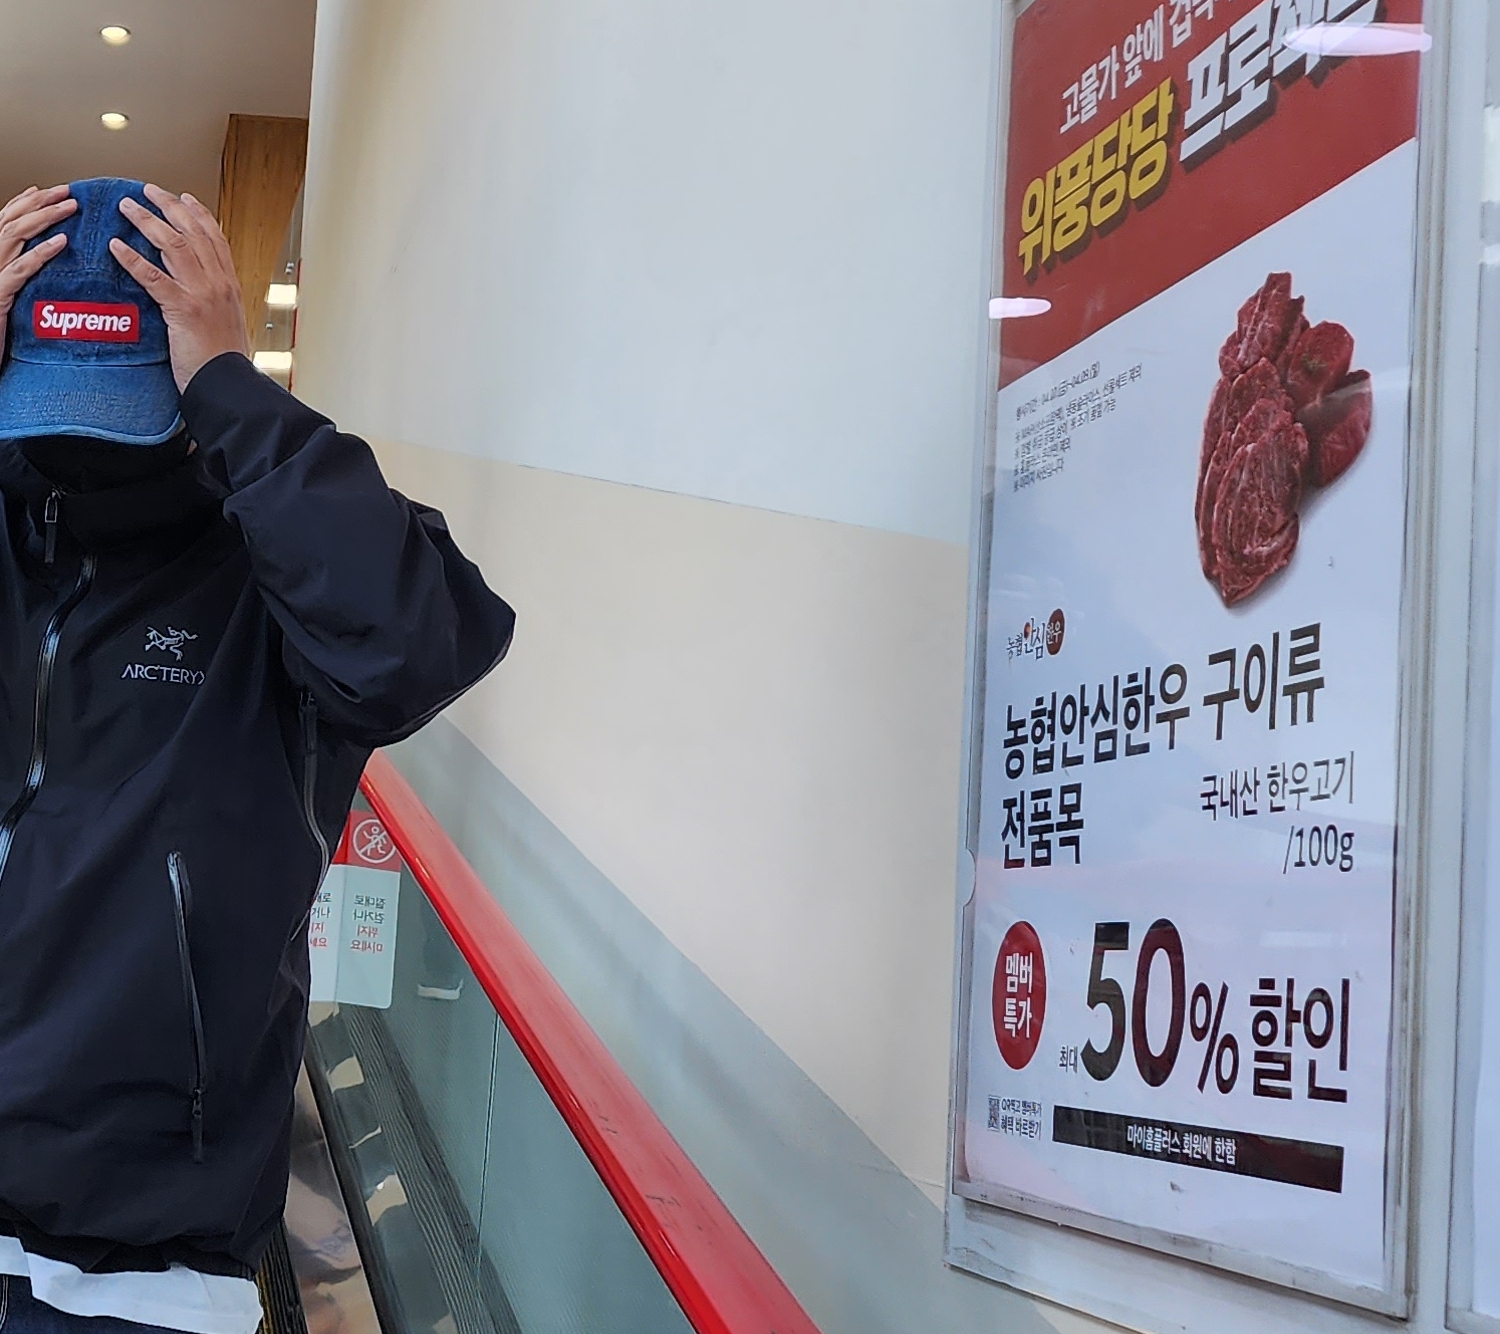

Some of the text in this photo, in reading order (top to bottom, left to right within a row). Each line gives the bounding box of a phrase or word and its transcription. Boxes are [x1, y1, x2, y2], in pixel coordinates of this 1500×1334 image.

[1059, 45, 1120, 134] 고물가
[1122, 3, 1165, 88] 앞에
[1018, 76, 1175, 275] 위풍당당
[40, 304, 132, 335] Supreme
[1002, 622, 1325, 779] 농협안심한우 구이류
[1199, 750, 1355, 820] 국내산 한우고기
[1000, 782, 1084, 869] 전품목
[1282, 822, 1355, 875] /100g
[1004, 952, 1034, 994] 멤버
[1003, 997, 1033, 1039] 특가
[1059, 918, 1350, 1104] 최대 50% 할인
[1127, 1123, 1236, 1166] 마이홈플러스 회원에 한함
